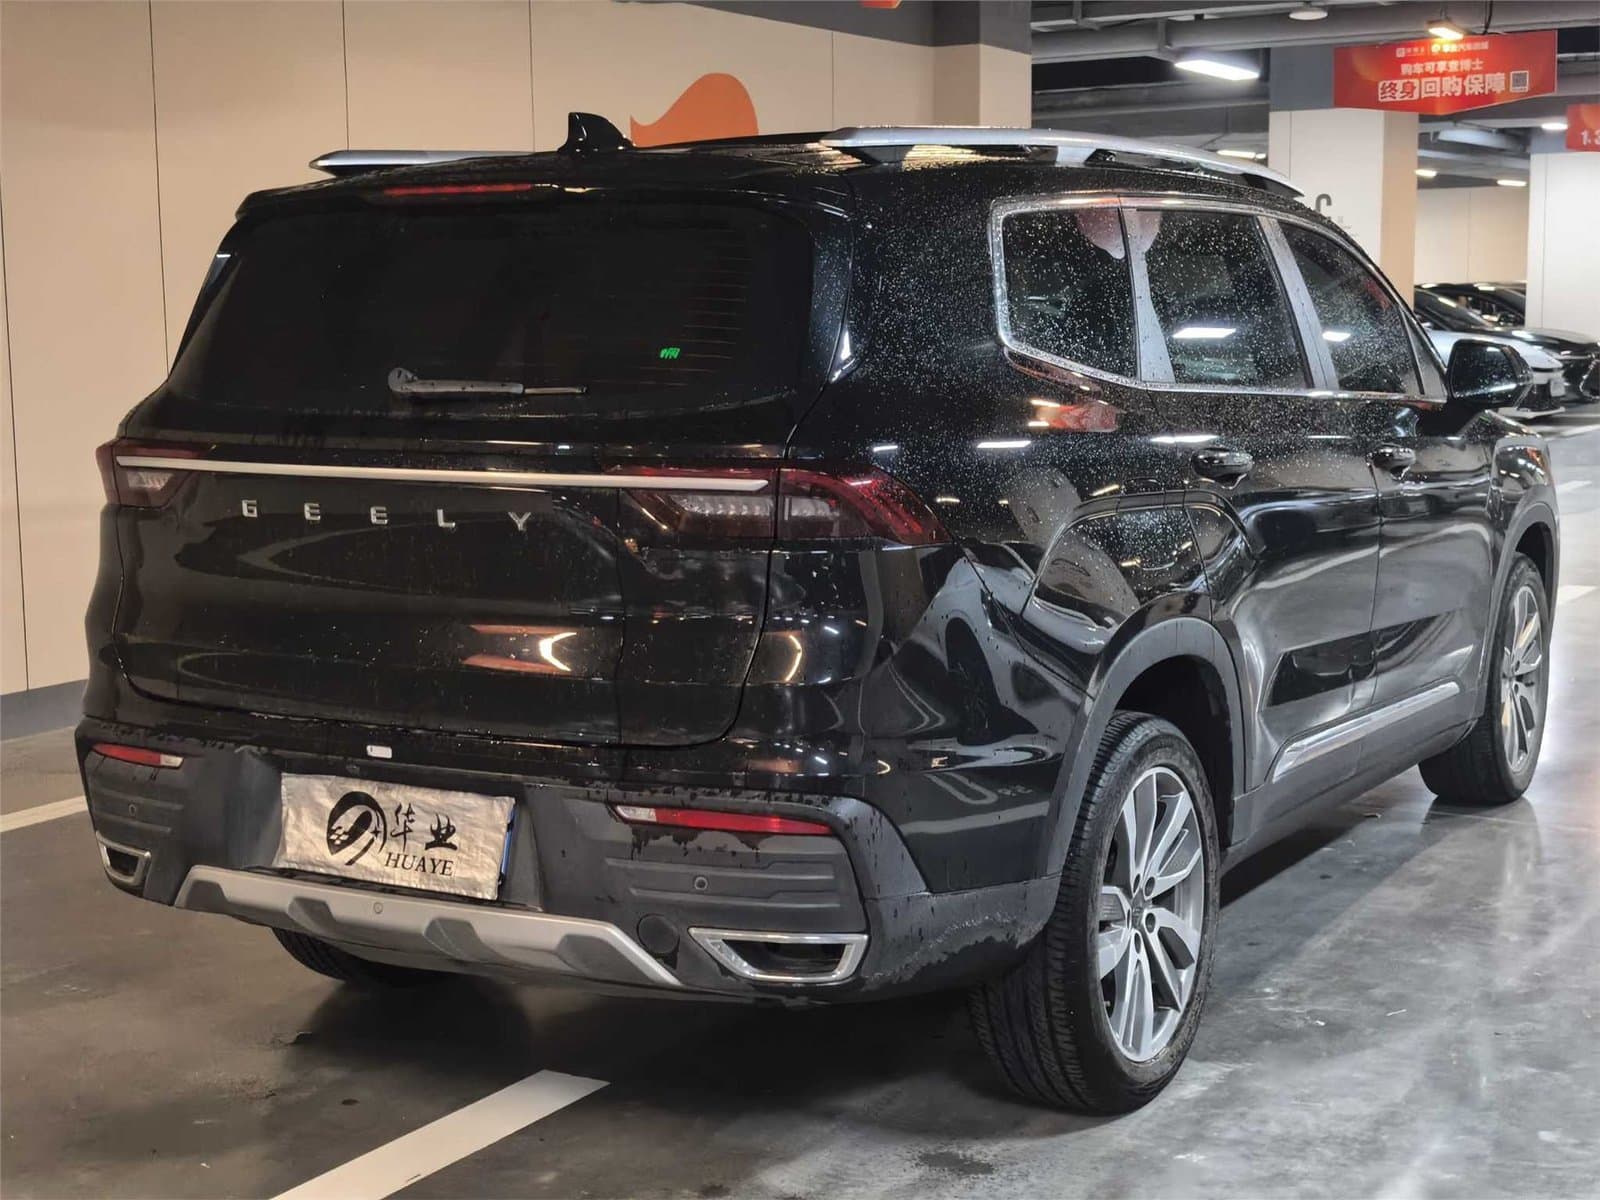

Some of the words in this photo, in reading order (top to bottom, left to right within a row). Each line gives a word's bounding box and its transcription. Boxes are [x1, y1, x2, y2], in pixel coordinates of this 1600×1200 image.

[1379, 73, 1505, 101] 终身回购保障
[241, 499, 532, 532] GEELY
[390, 803, 458, 851] 华业
[385, 852, 454, 877] HUAYE
